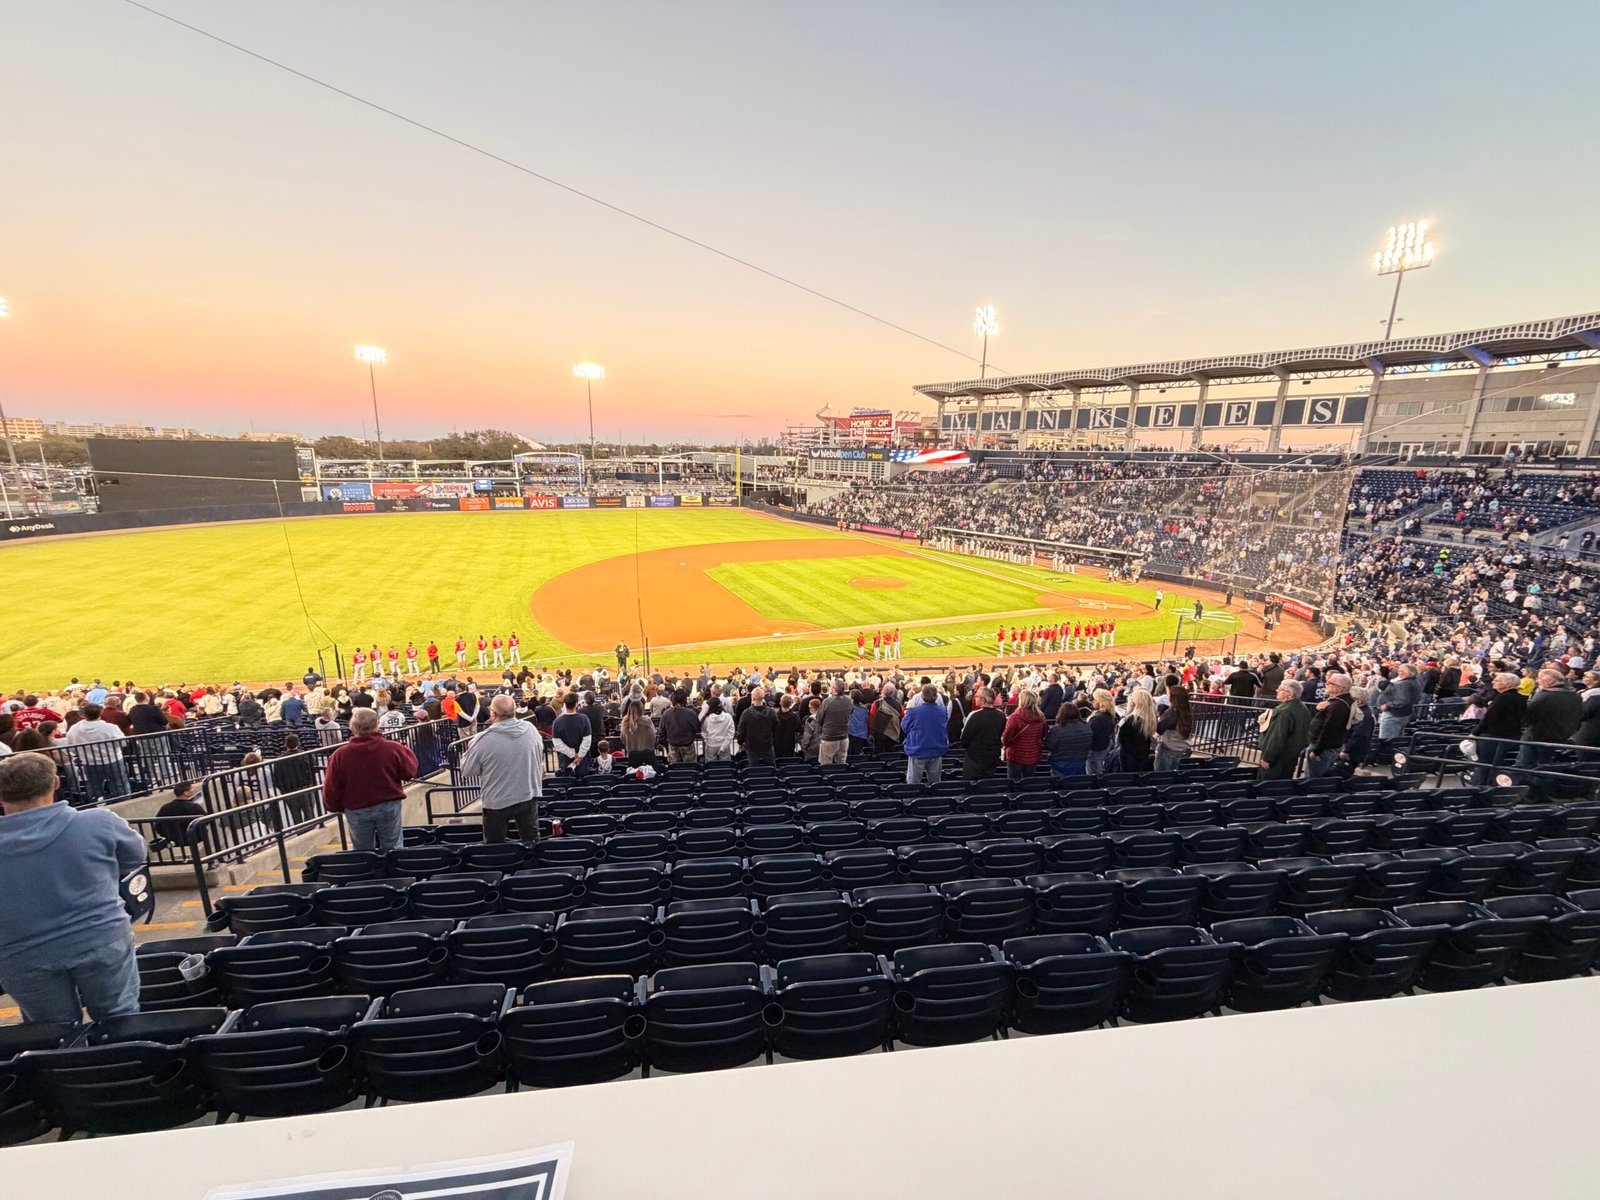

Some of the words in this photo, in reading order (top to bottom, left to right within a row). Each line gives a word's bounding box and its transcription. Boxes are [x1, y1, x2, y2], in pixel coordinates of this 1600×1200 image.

[953, 400, 1333, 429] YANKEES
[851, 420, 873, 428] HOME
[878, 419, 889, 427] OF
[853, 450, 867, 459] Club
[343, 504, 376, 512] HOOTERS
[531, 499, 555, 508] AVIS
[21, 522, 55, 532] AnyDesk
[22, 720, 41, 731] 37
[387, 718, 400, 727] 99
